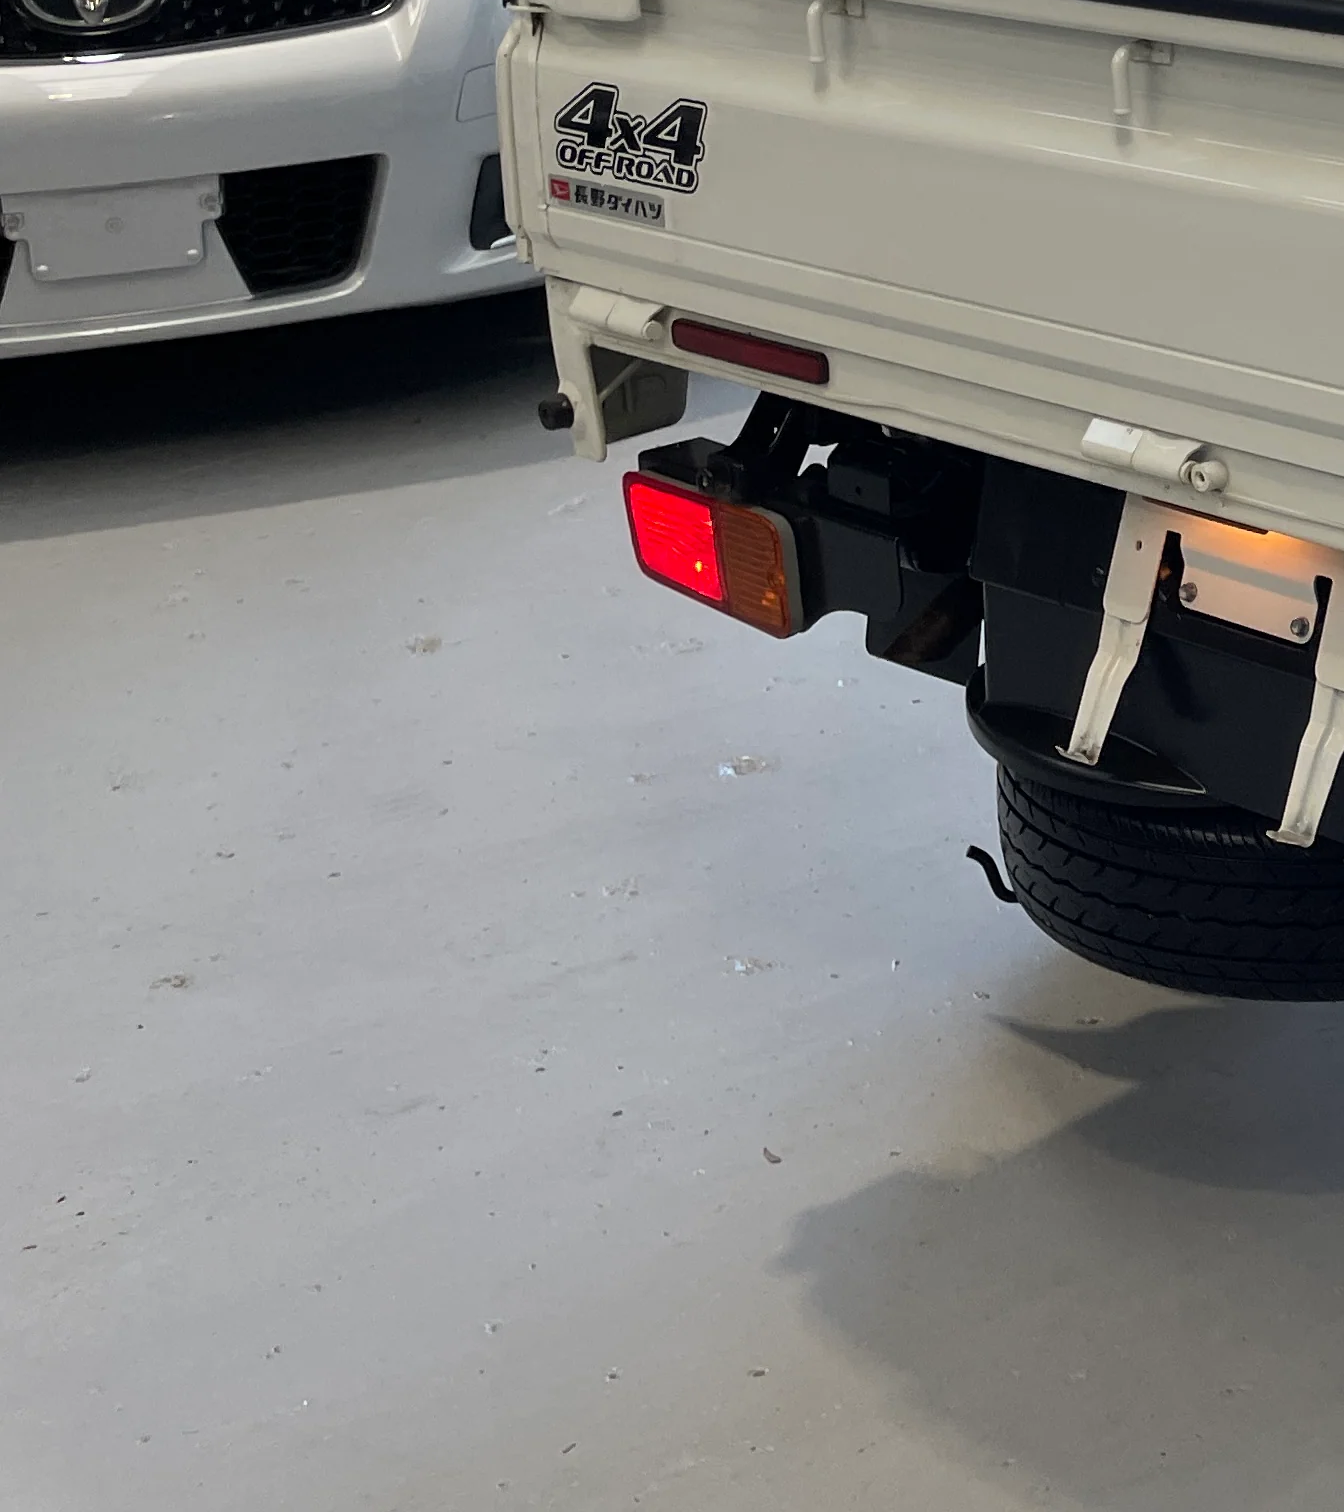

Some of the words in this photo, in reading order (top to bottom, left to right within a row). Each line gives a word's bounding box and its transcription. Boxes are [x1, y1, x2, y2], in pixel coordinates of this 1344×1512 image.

[558, 143, 615, 173] OFF
[613, 154, 697, 190] ROAD
[574, 184, 662, 220] 長野ダイハツ
